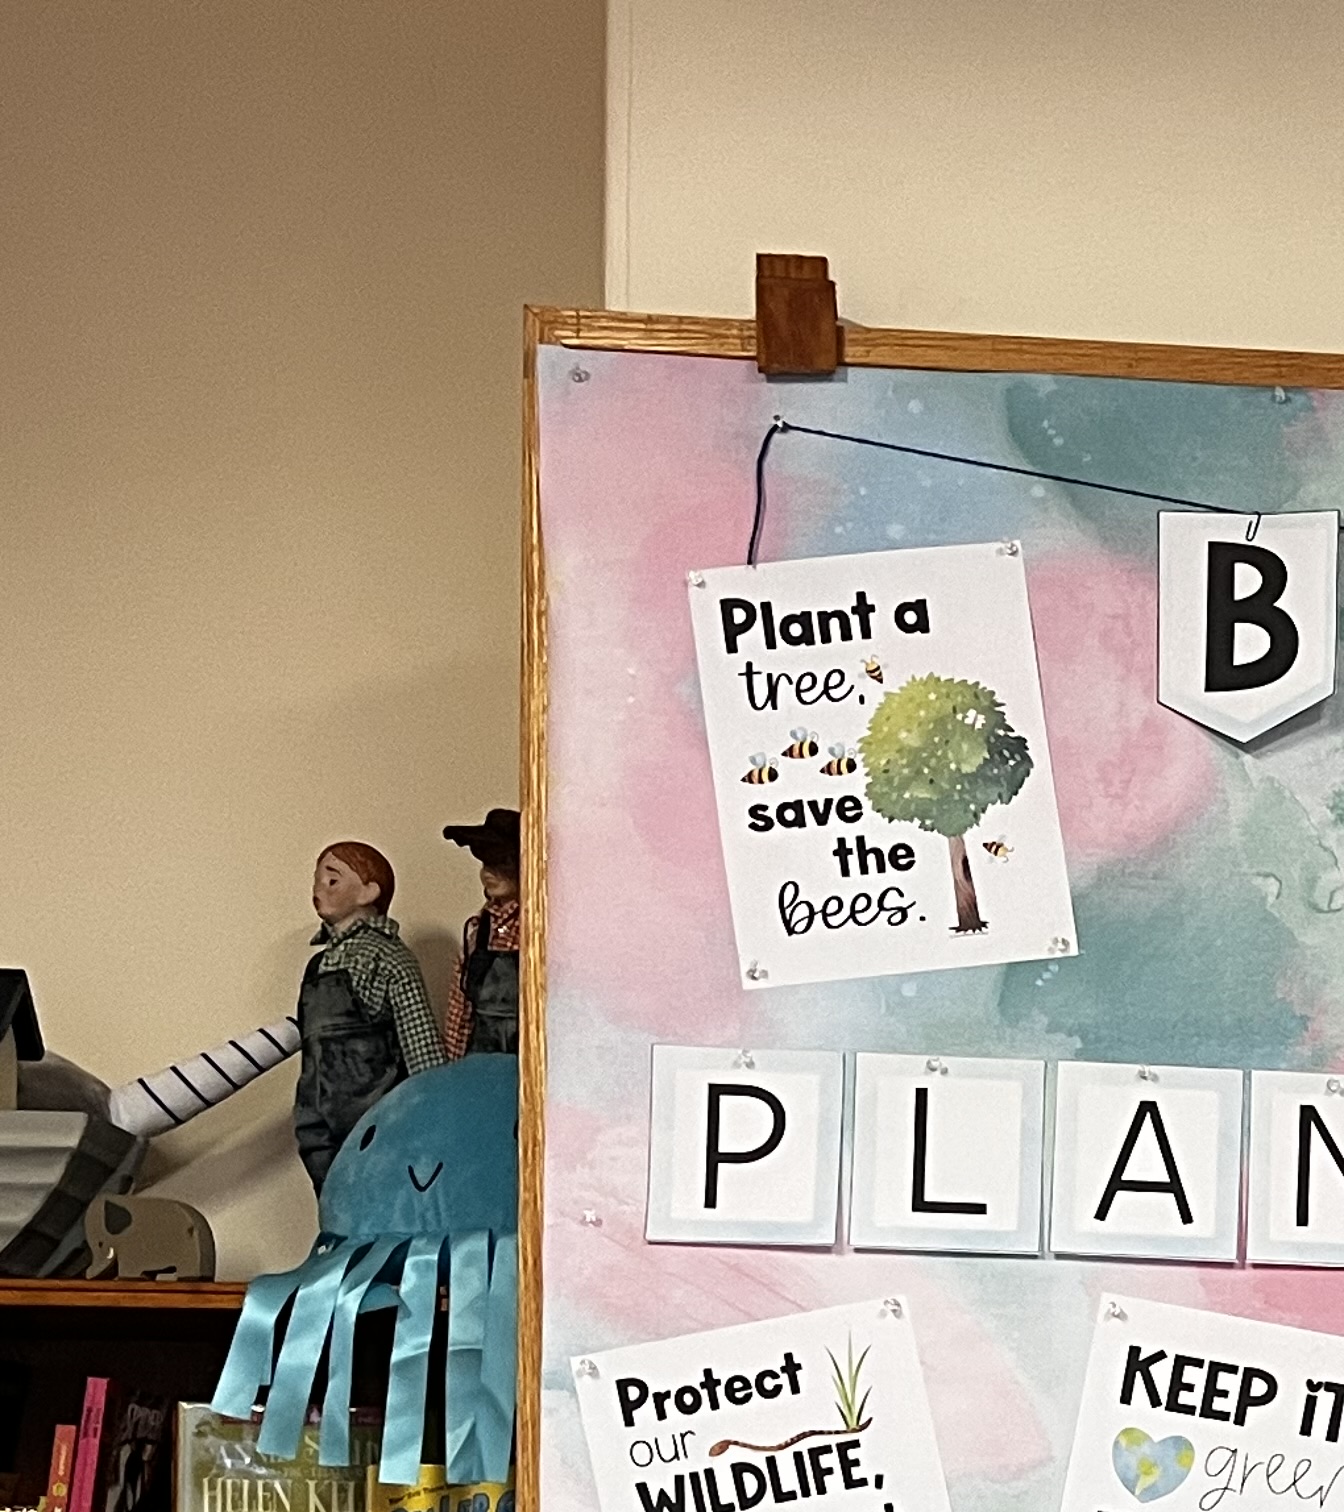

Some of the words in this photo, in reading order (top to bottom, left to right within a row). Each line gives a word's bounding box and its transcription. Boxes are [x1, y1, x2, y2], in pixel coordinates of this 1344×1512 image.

[720, 591, 876, 655] Plant
[894, 594, 930, 635] a
[739, 659, 866, 712] tree.
[748, 791, 863, 832] save
[833, 837, 915, 876] the
[779, 880, 926, 936] bees.
[615, 1352, 803, 1428] Protect
[1119, 1345, 1277, 1427] KEEP
[629, 1429, 696, 1469] our
